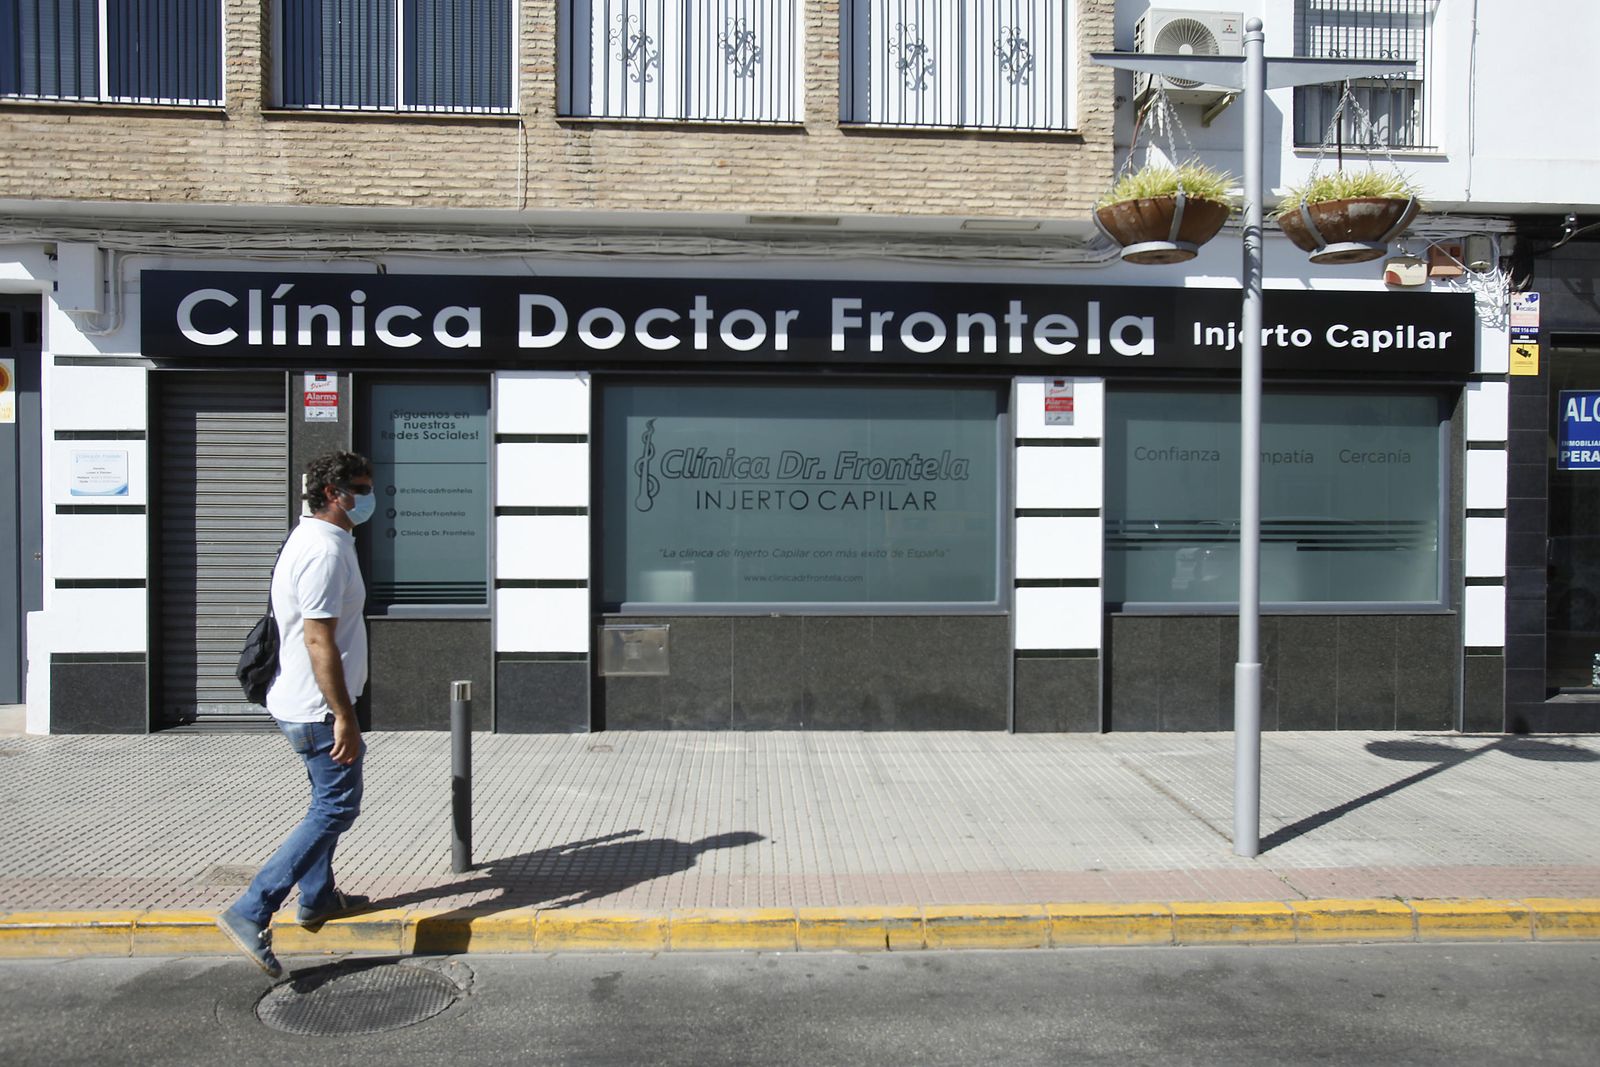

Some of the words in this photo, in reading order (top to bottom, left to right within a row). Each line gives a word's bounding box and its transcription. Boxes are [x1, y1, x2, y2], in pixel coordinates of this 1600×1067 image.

[176, 283, 482, 348] Clínica
[518, 293, 800, 351] Doctor
[831, 298, 1155, 357] Frontela
[1193, 321, 1313, 351] Injrto
[1325, 324, 1452, 353] Capilar
[306, 392, 337, 401] Alarma
[454, 410, 470, 419] en
[403, 421, 456, 430] nuestras
[381, 430, 420, 440] Redes
[422, 430, 479, 440] Sociales!
[660, 447, 770, 480] Clínica
[776, 450, 826, 480] Dr.
[834, 450, 970, 481] Frontela
[1134, 446, 1221, 462] Confianza
[1258, 449, 1315, 466] mpatía
[1338, 449, 1412, 464] Cercanía
[696, 489, 810, 511] INJERTO
[818, 490, 938, 511] CAPILAR
[716, 548, 730, 559] de
[734, 548, 770, 560] Injerto
[772, 548, 810, 560] Capilar
[812, 550, 833, 559] con
[891, 548, 905, 559] de
